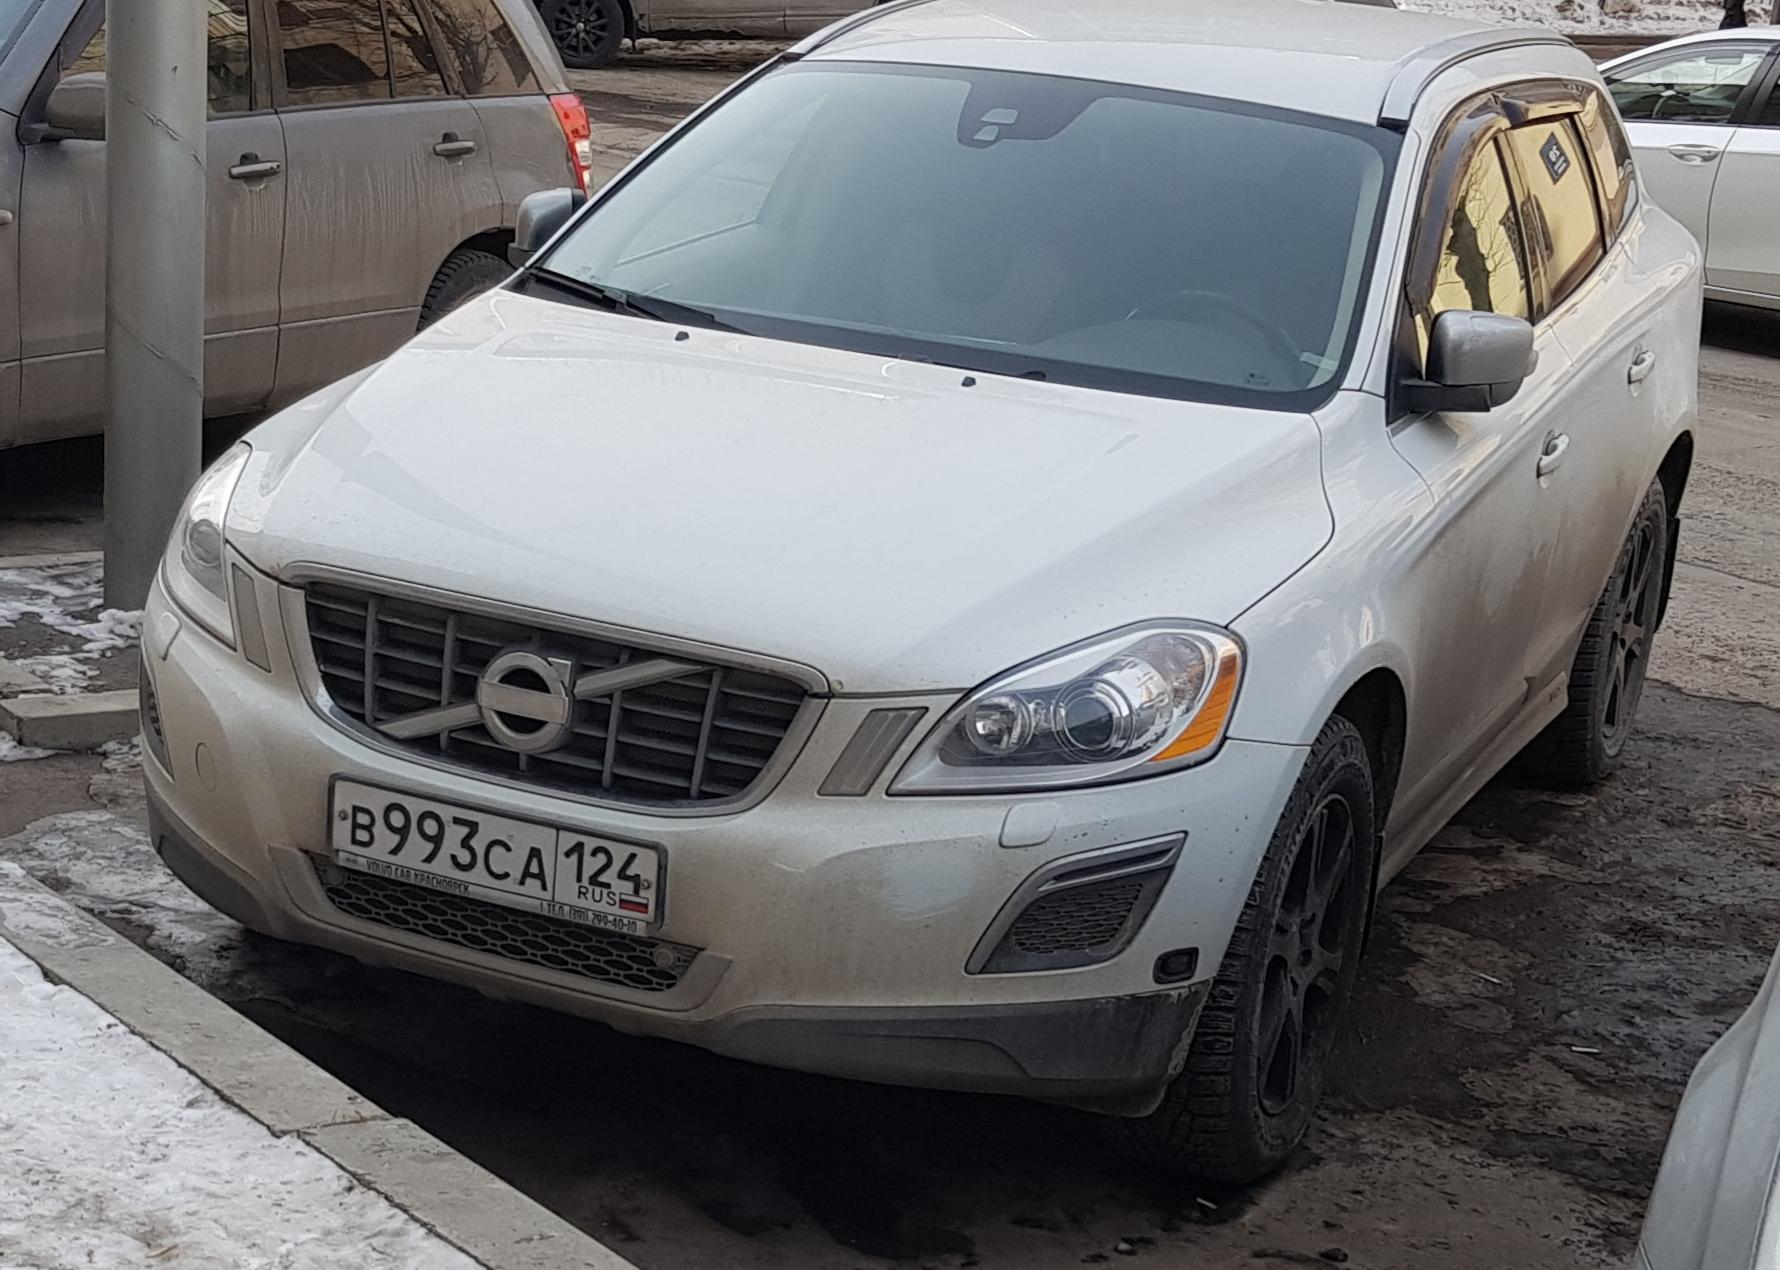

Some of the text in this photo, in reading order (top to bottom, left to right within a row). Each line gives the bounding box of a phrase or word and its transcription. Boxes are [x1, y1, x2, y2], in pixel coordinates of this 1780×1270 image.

[366, 860, 393, 877] VOLVO
[564, 841, 641, 895] 124
[577, 885, 617, 906] RUS
[591, 912, 637, 933] 299-40-10
